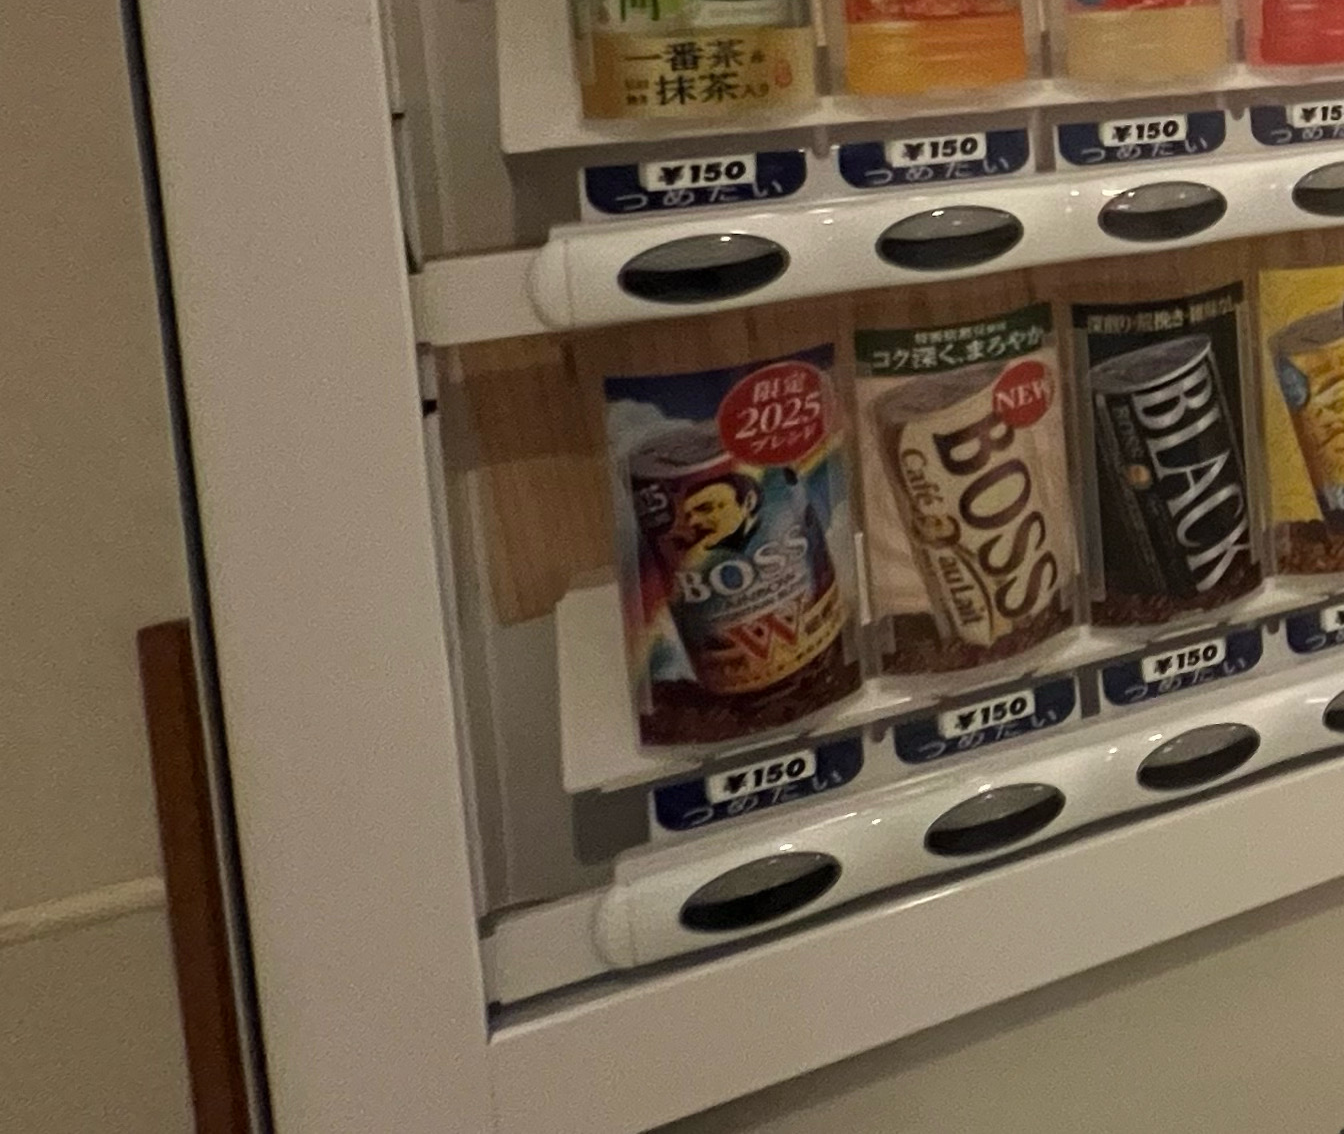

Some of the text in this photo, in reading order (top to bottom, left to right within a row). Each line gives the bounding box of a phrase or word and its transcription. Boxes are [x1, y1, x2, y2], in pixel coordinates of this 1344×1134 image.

[1112, 119, 1180, 143] ¥150
[902, 136, 978, 161] ¥150
[660, 161, 747, 186] ¥150
[997, 380, 1053, 413] NEW
[735, 394, 822, 441] 2025
[1129, 363, 1253, 594] BLACK
[932, 415, 1060, 620] BOSS
[679, 532, 811, 603] BOSS
[1153, 643, 1218, 676] ¥150
[954, 696, 1028, 730] ¥150
[722, 756, 807, 795] ¥150
